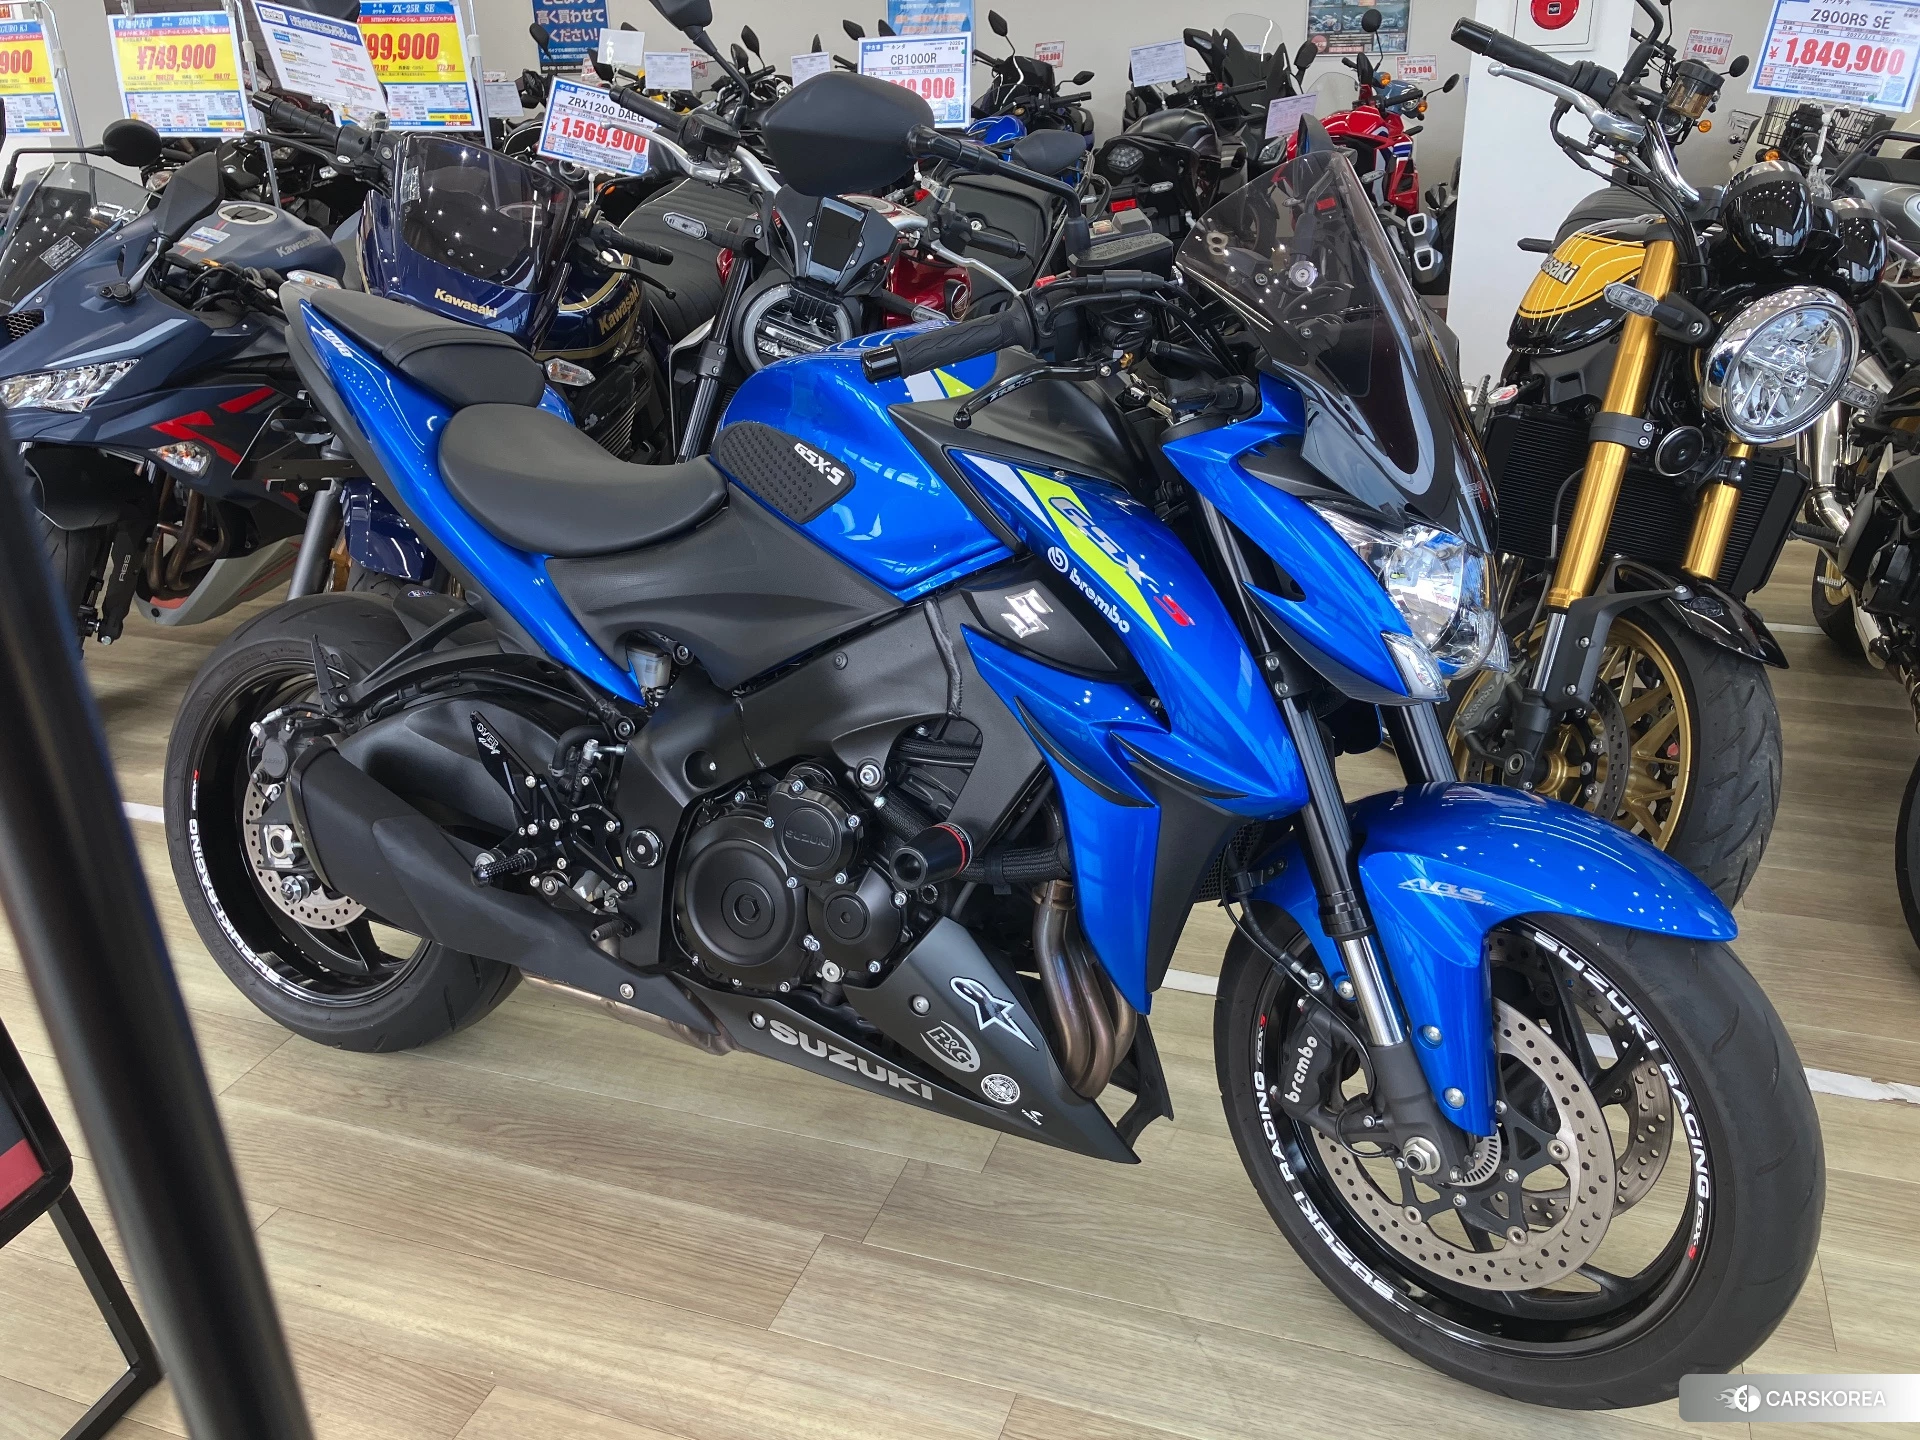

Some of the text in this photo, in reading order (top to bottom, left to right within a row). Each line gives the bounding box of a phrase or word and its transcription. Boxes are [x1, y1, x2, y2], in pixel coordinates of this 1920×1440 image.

[392, 4, 435, 13] ZX-25R SE
[536, 8, 605, 25] 高く買わせて
[1811, 9, 1892, 29] Z900RS SE
[364, 32, 440, 62] 99,900
[549, 27, 599, 42] ください!
[137, 43, 217, 73] ¥749,900
[890, 52, 937, 65] CB1000R
[1768, 37, 1906, 76] ¥ 1,849,900
[567, 96, 645, 123] ZRX1200 DAEG
[585, 91, 606, 100] カワサキ
[550, 121, 558, 132] ¥
[561, 117, 648, 154] 1,569,900
[276, 234, 321, 258] Kawasaki
[434, 288, 498, 318] Kawasaki
[794, 442, 846, 486] GSX-S
[1069, 567, 1131, 634] brembo
[785, 829, 831, 848] SUZUKI
[189, 817, 219, 904] RACING
[1398, 878, 1487, 903] ABS
[769, 1019, 934, 1101] SUZUKI
[1284, 1035, 1319, 1104] brembo
[1533, 931, 1660, 1052] SUZUKI
[1659, 1062, 1710, 1200] RACING
[1253, 1070, 1296, 1183] RACING
[1293, 1190, 1395, 1301] SUZUKI
